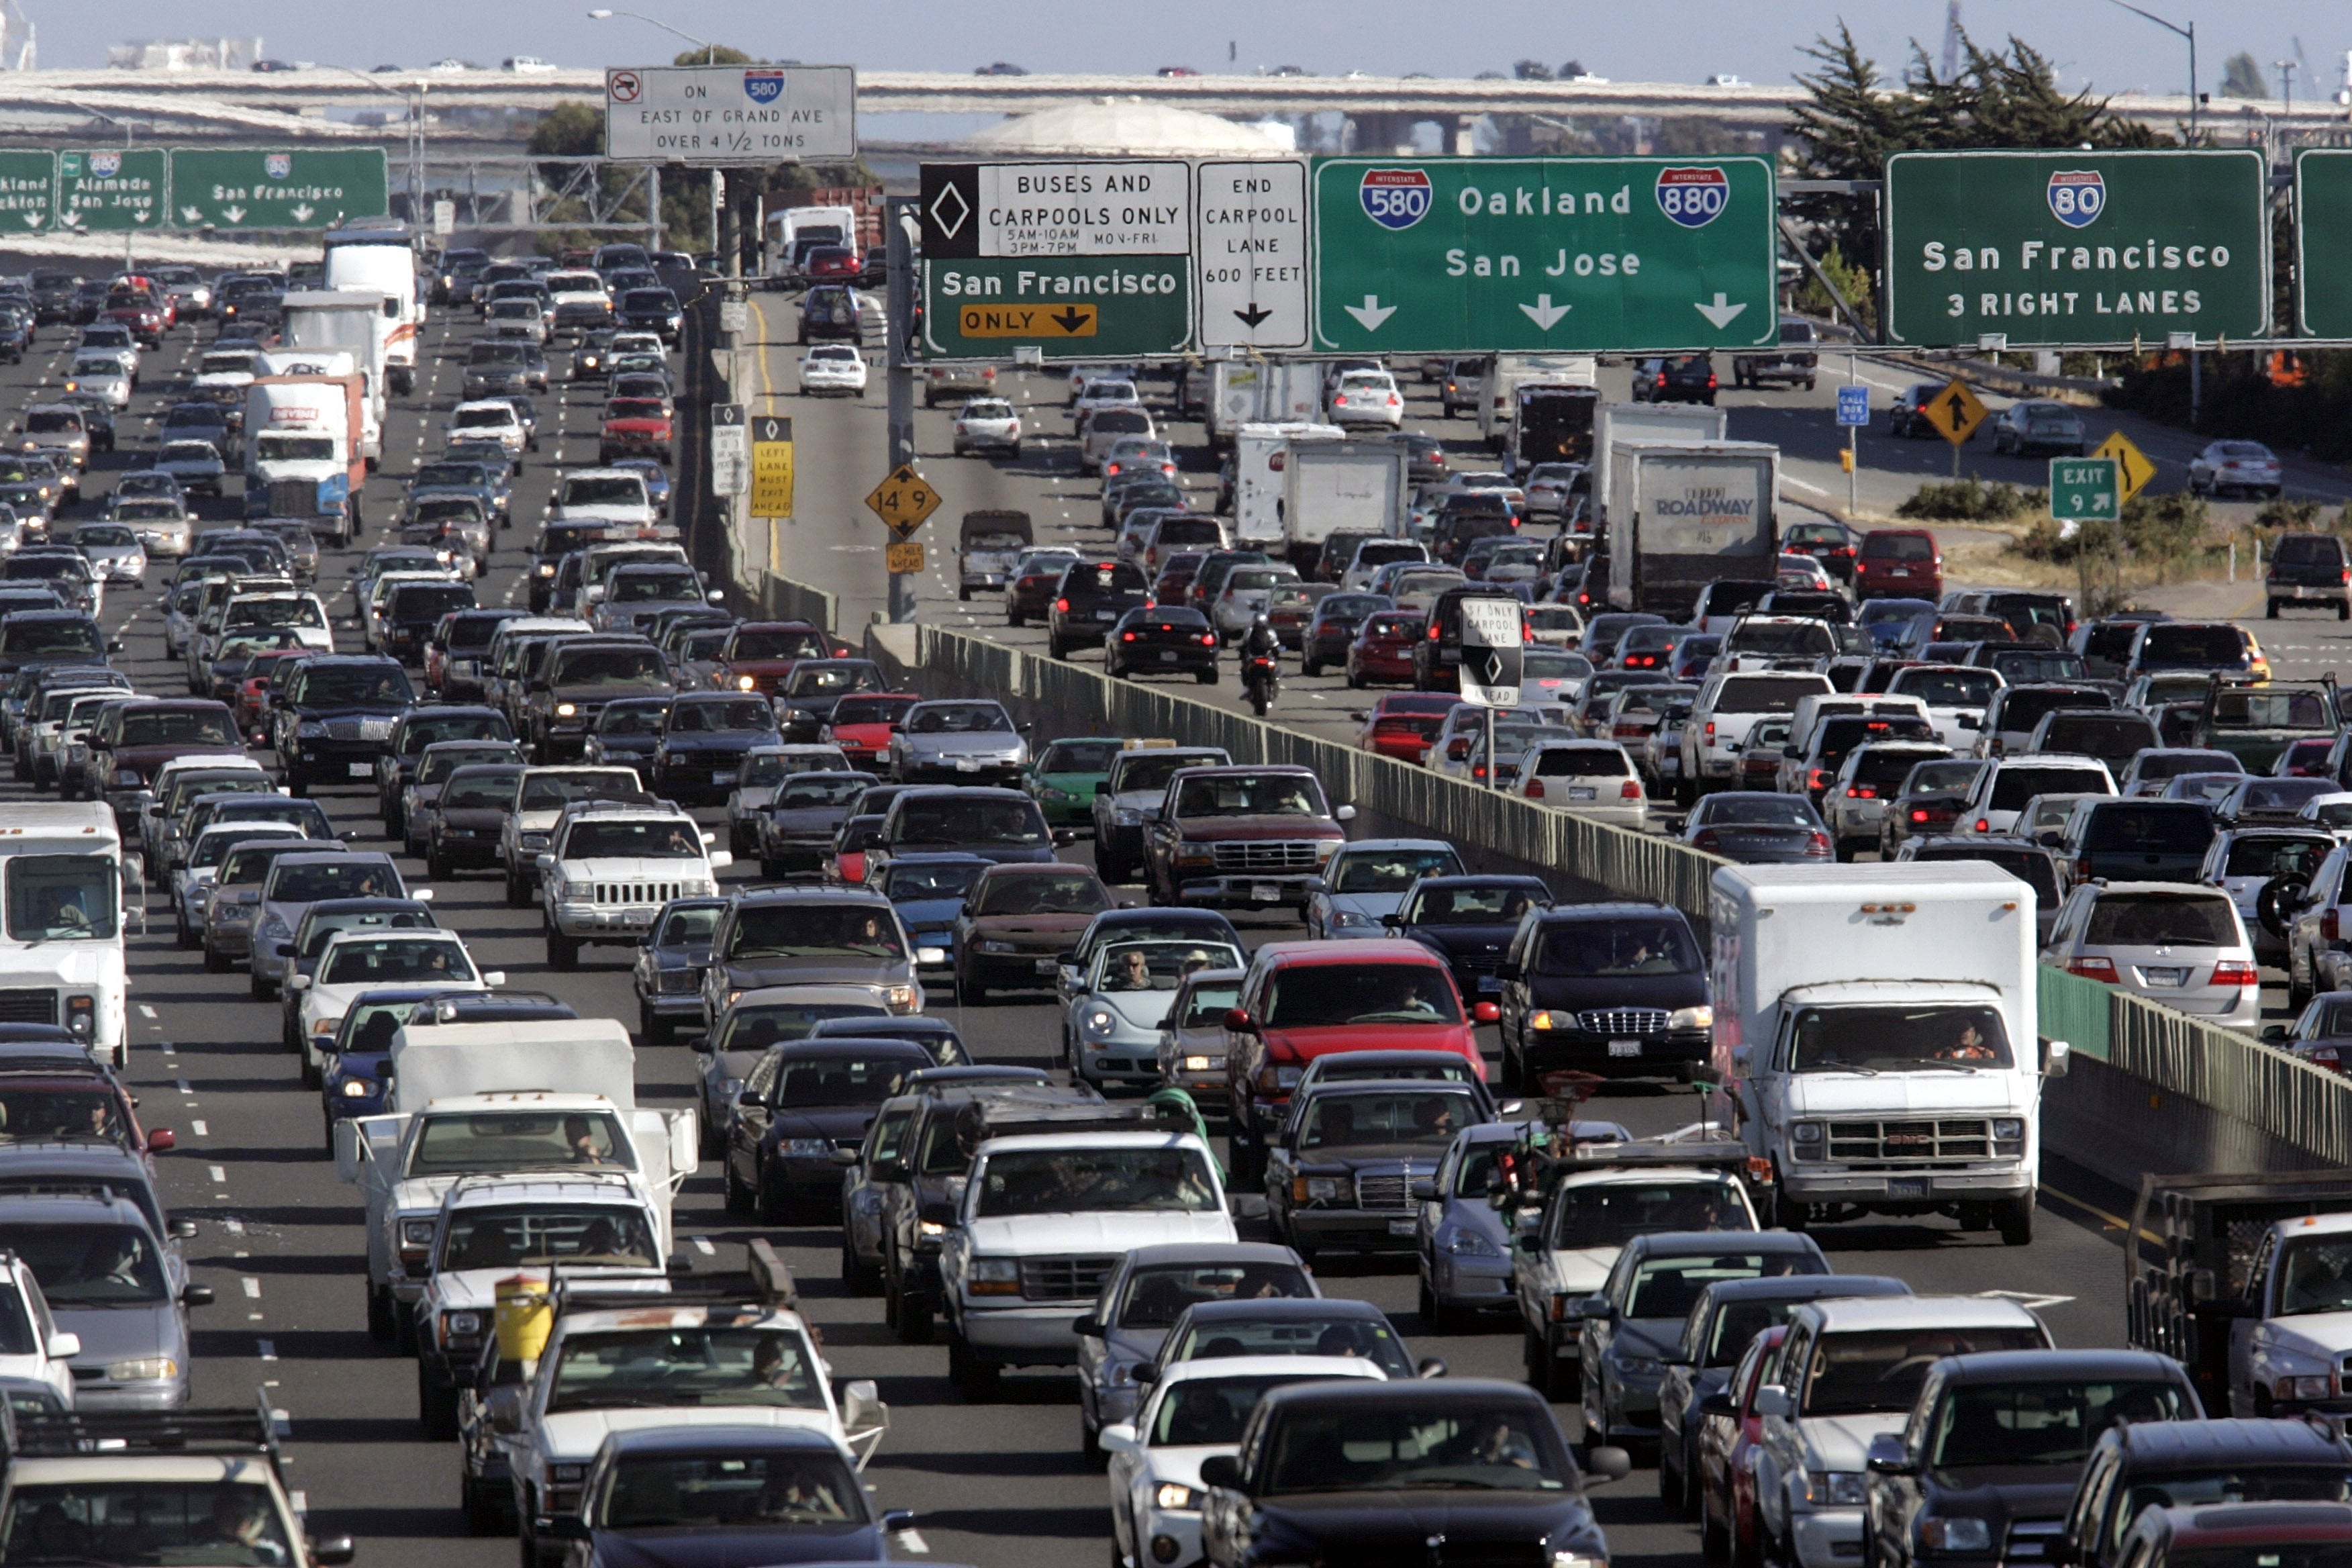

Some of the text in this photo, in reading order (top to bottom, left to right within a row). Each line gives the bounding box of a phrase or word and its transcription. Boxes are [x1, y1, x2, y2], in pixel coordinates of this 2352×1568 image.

[685, 82, 777, 98] ON 580
[642, 109, 824, 124] EAST OF GRAND AVE
[657, 135, 700, 148] OVER
[710, 136, 720, 148] 4
[763, 135, 804, 148] TONS
[75, 177, 152, 191] Alameda
[1018, 175, 1151, 193] BUSES AND
[1233, 179, 1271, 193] END
[212, 184, 344, 201] San Francisco
[1459, 185, 1632, 215] Oakland
[70, 194, 153, 208] San Jose
[1371, 189, 1424, 216] 580
[1665, 187, 1721, 215] 880
[2056, 187, 2100, 215] 80
[989, 207, 1178, 226] CARPOOLS ONLY
[1206, 208, 1297, 224] CARPOOL
[1008, 229, 1079, 240] 5AM-10AM
[1010, 242, 1077, 254] 3PM-7PM
[1228, 239, 1279, 253] LANE
[1446, 248, 1640, 277] San Jose
[1923, 239, 2230, 271] San Francisco
[942, 268, 1176, 295] San Francisco
[1206, 267, 1300, 283] 600 FEET
[1947, 289, 2202, 317] 3 RIGHT LANES
[965, 312, 1035, 330] ONLY
[760, 448, 785, 458] LEFT
[759, 462, 788, 471] LANE
[759, 476, 787, 484] MUST
[2063, 468, 2106, 484] EXIT
[761, 489, 783, 497] EXIT
[754, 503, 791, 511] AHEAD
[1656, 499, 1754, 516] ROADWAY
[2070, 493, 2084, 511] 9
[1488, 604, 1513, 617] ONLY
[1467, 620, 1515, 630] CARPOOL
[1479, 633, 1507, 643] LANE
[1887, 1135, 1929, 1144] GMC
